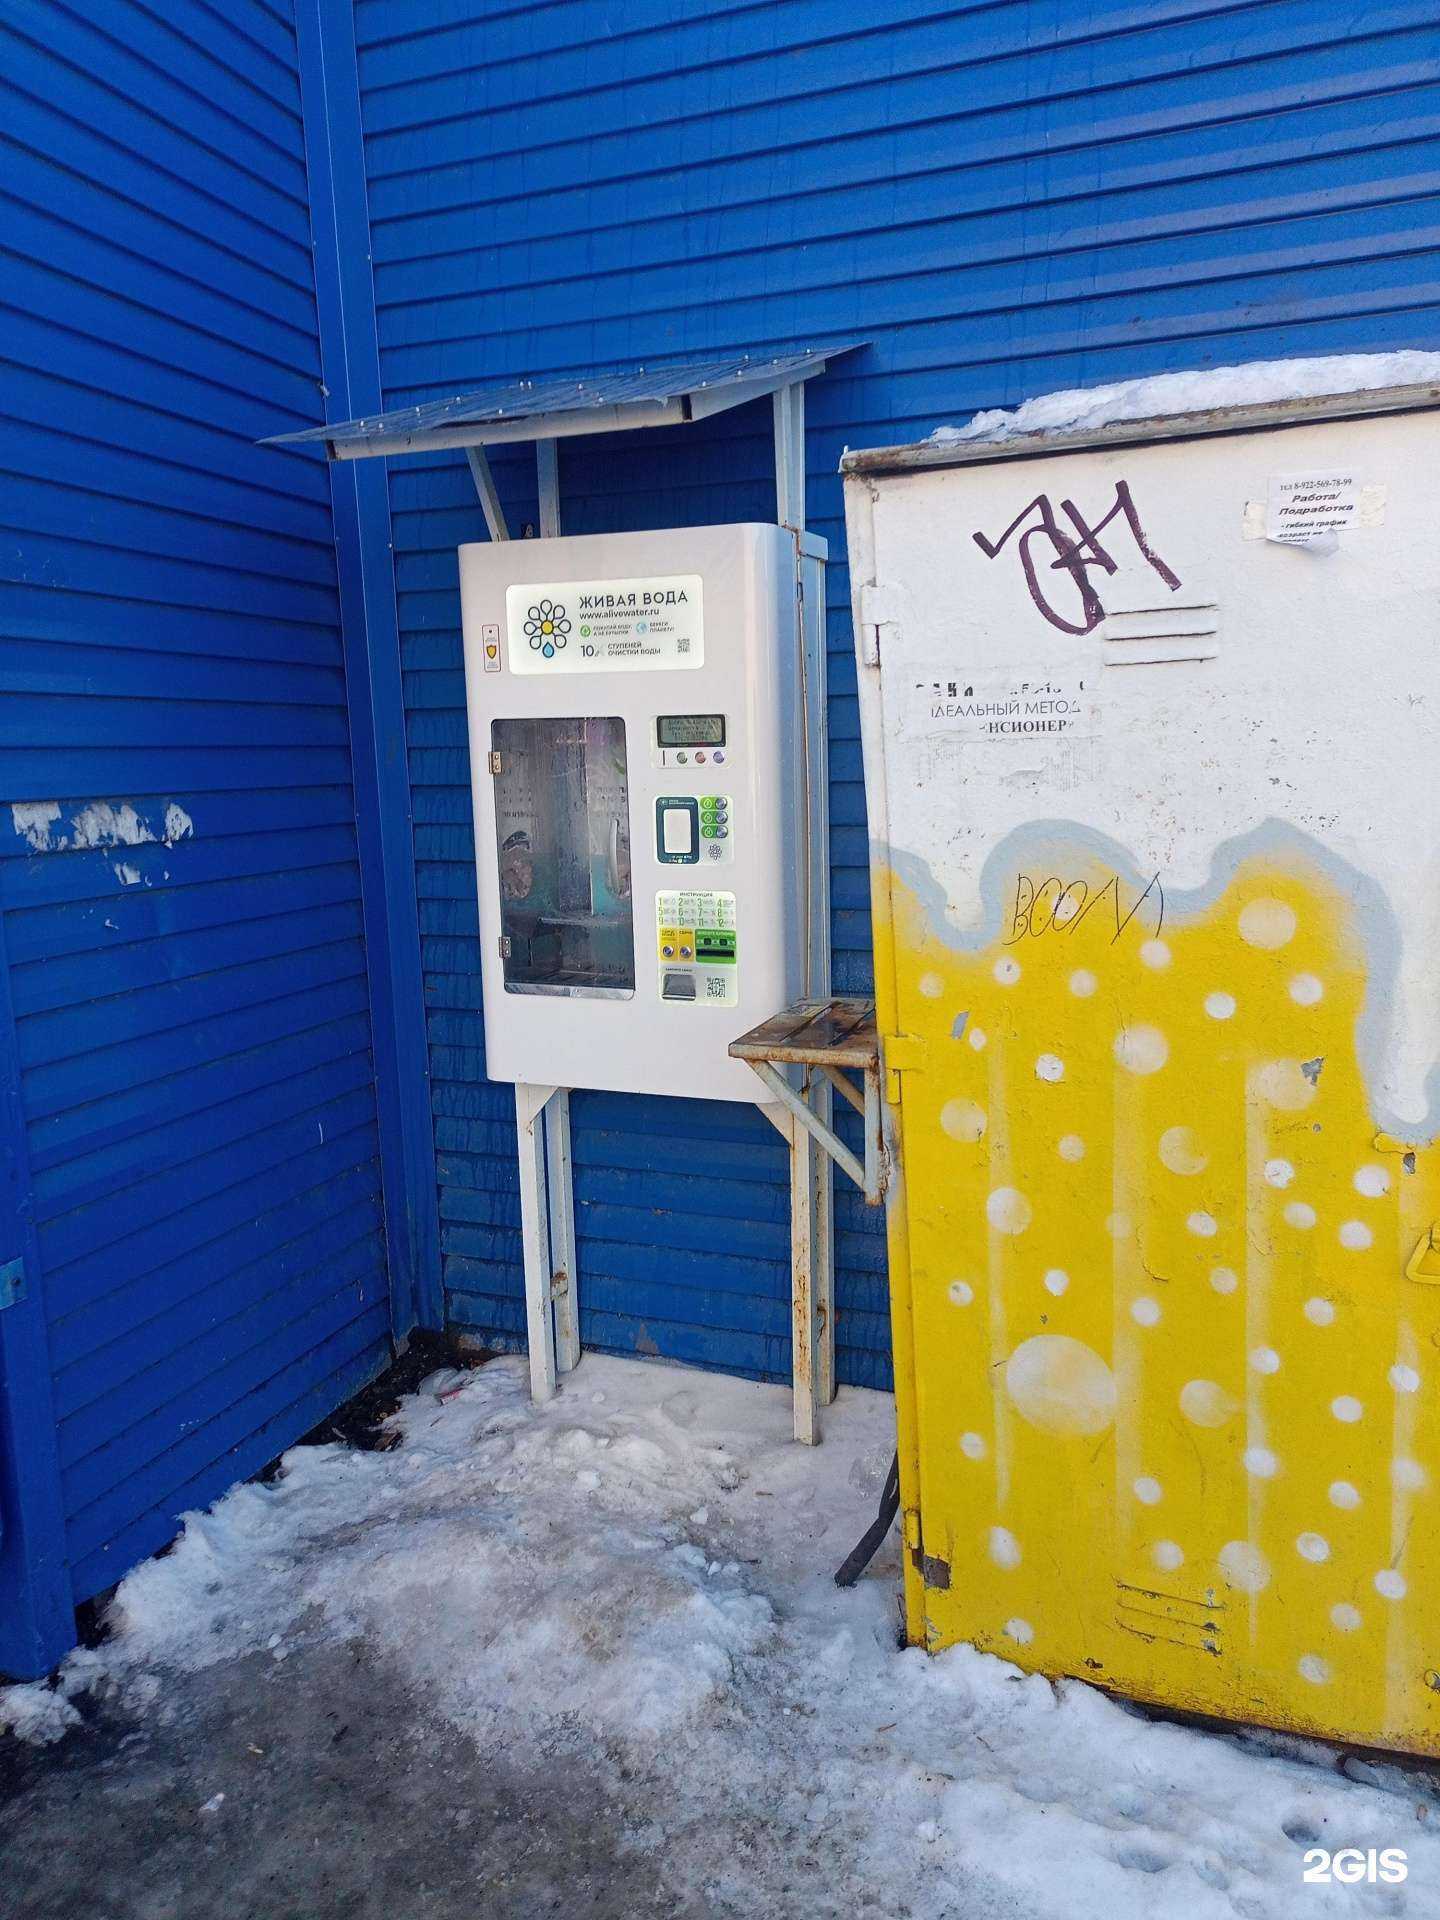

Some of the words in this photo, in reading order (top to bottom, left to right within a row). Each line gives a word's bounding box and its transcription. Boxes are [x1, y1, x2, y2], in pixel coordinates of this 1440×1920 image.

[1292, 492, 1341, 503] Работа/
[1278, 504, 1353, 516] Подработка
[580, 593, 636, 609] ЖИВАЯ
[643, 590, 688, 606] ВОДА
[580, 644, 594, 657] 10
[607, 649, 639, 657] ОЧИСТКИ
[641, 648, 661, 656] ВОДЫ
